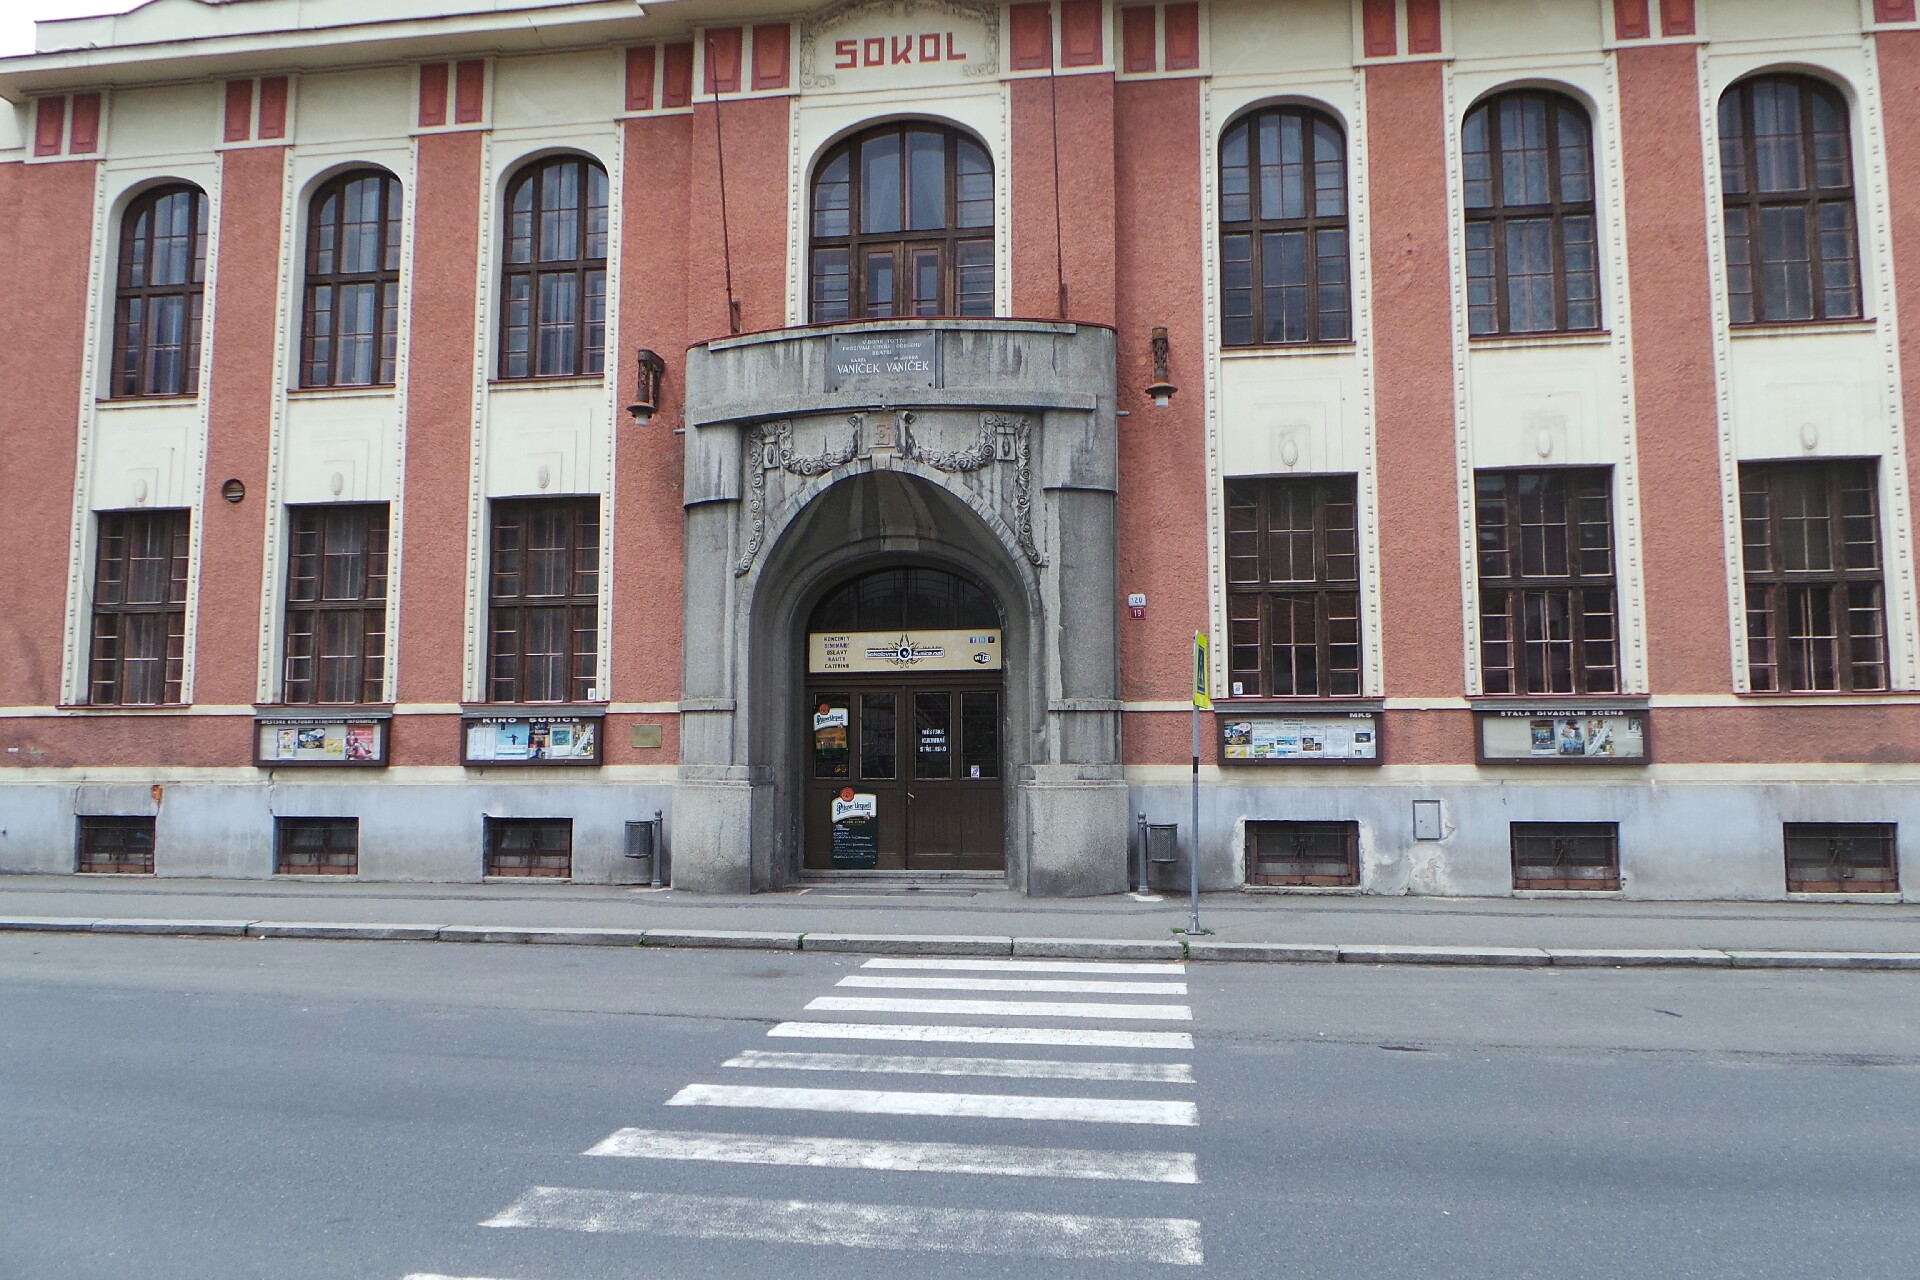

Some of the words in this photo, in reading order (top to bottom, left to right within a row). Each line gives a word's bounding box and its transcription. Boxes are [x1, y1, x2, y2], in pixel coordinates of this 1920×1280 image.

[835, 32, 967, 69] SOKOL
[837, 362, 880, 375] VANÍČEK
[886, 360, 929, 373] VANÍČEK
[1134, 609, 1142, 617] 19
[836, 802, 854, 815] Pilsner
[854, 801, 871, 811] Urquell
